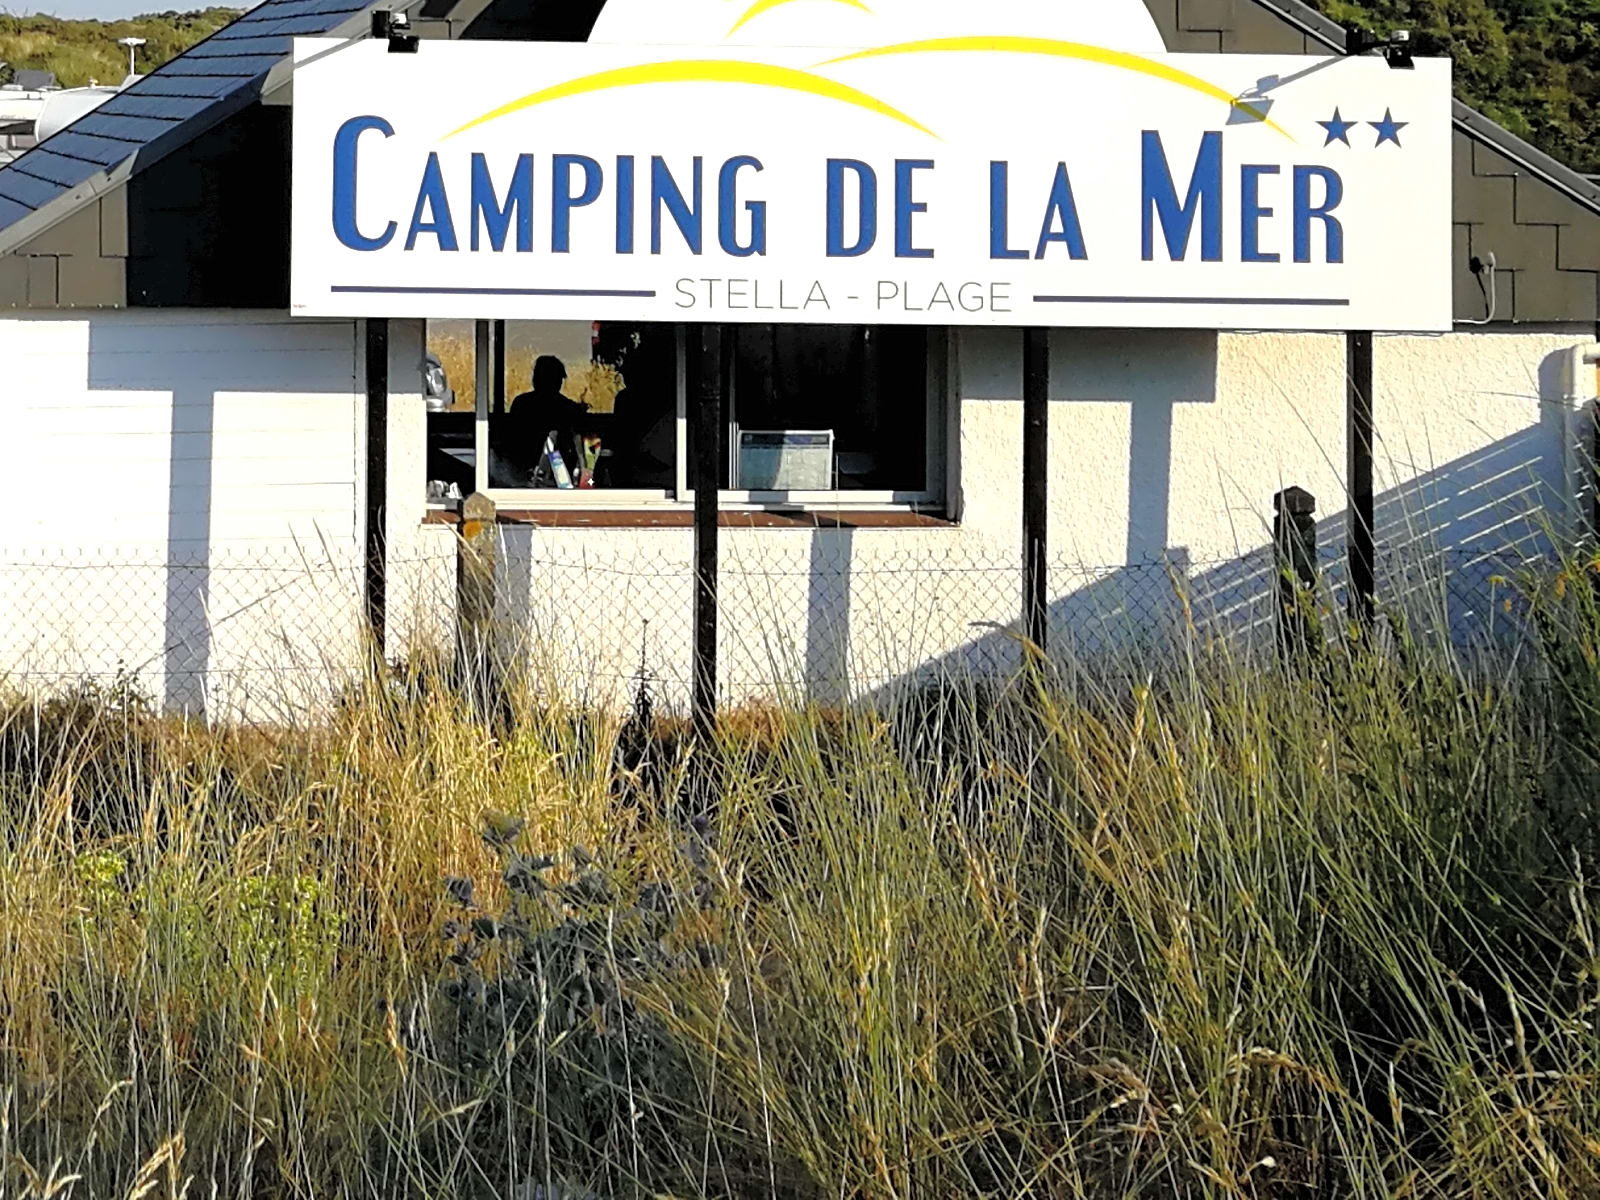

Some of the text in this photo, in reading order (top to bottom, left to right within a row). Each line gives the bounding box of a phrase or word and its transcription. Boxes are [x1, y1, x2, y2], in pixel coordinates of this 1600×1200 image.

[331, 115, 1343, 263] CAMPING DE LA MER
[675, 278, 831, 309] STELLA
[877, 280, 1012, 313] PLAGE
